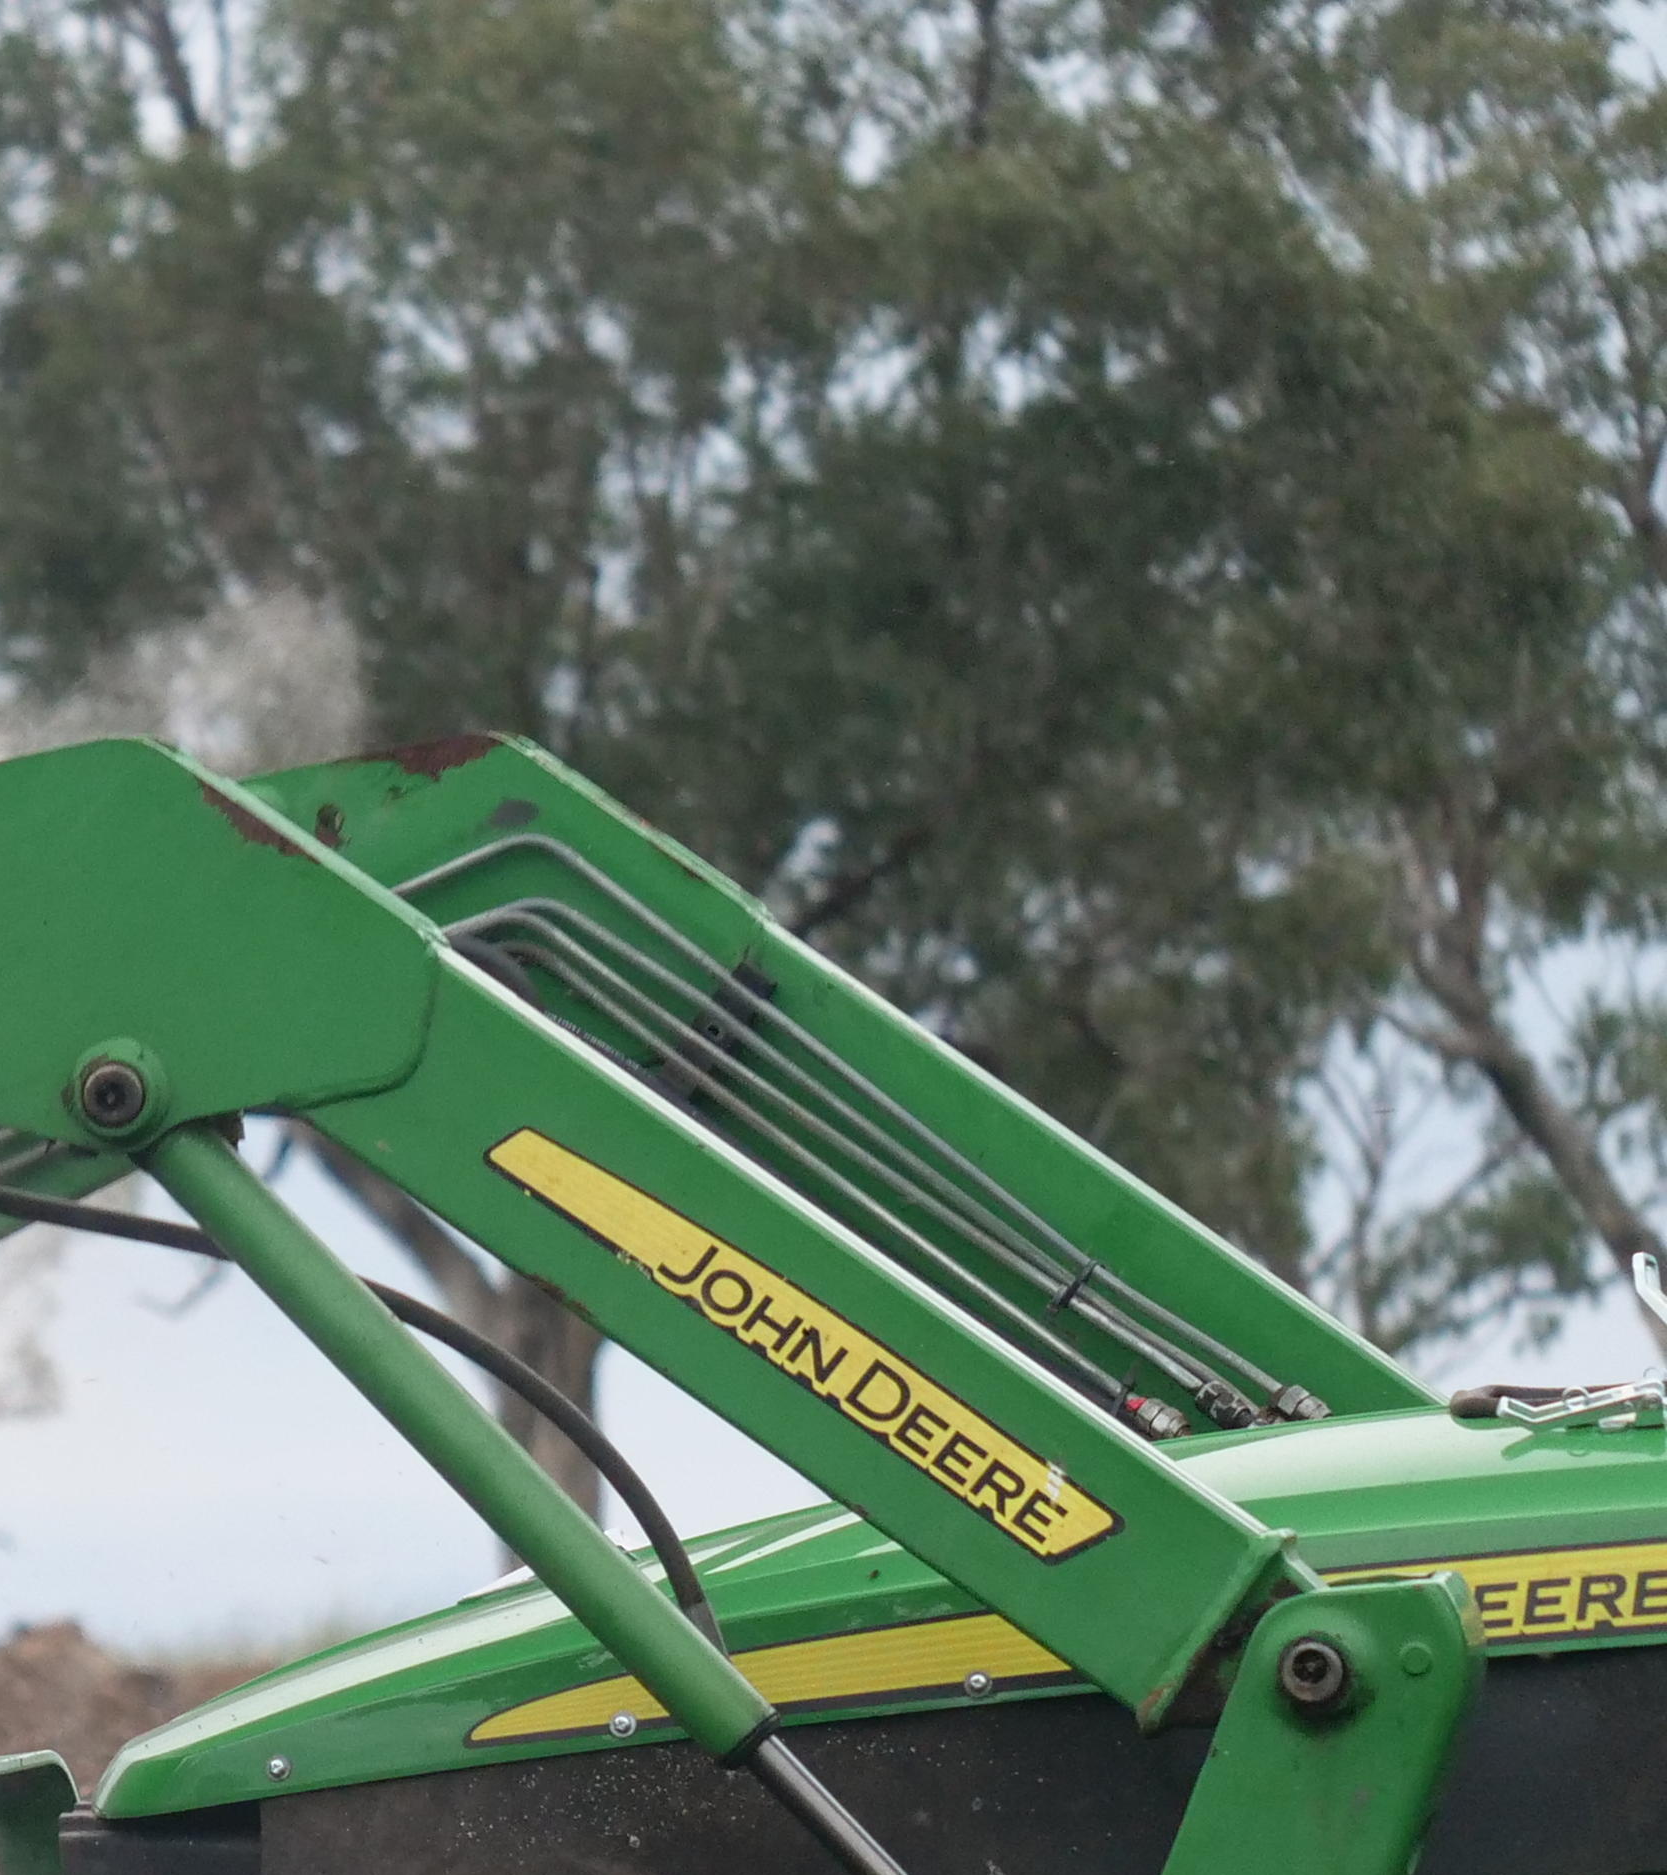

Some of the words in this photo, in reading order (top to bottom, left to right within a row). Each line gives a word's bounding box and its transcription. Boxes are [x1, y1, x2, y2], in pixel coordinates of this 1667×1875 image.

[657, 1245, 850, 1383] JOHN
[846, 1360, 1069, 1545] DEERE
[1474, 1569, 1667, 1629] EERE
